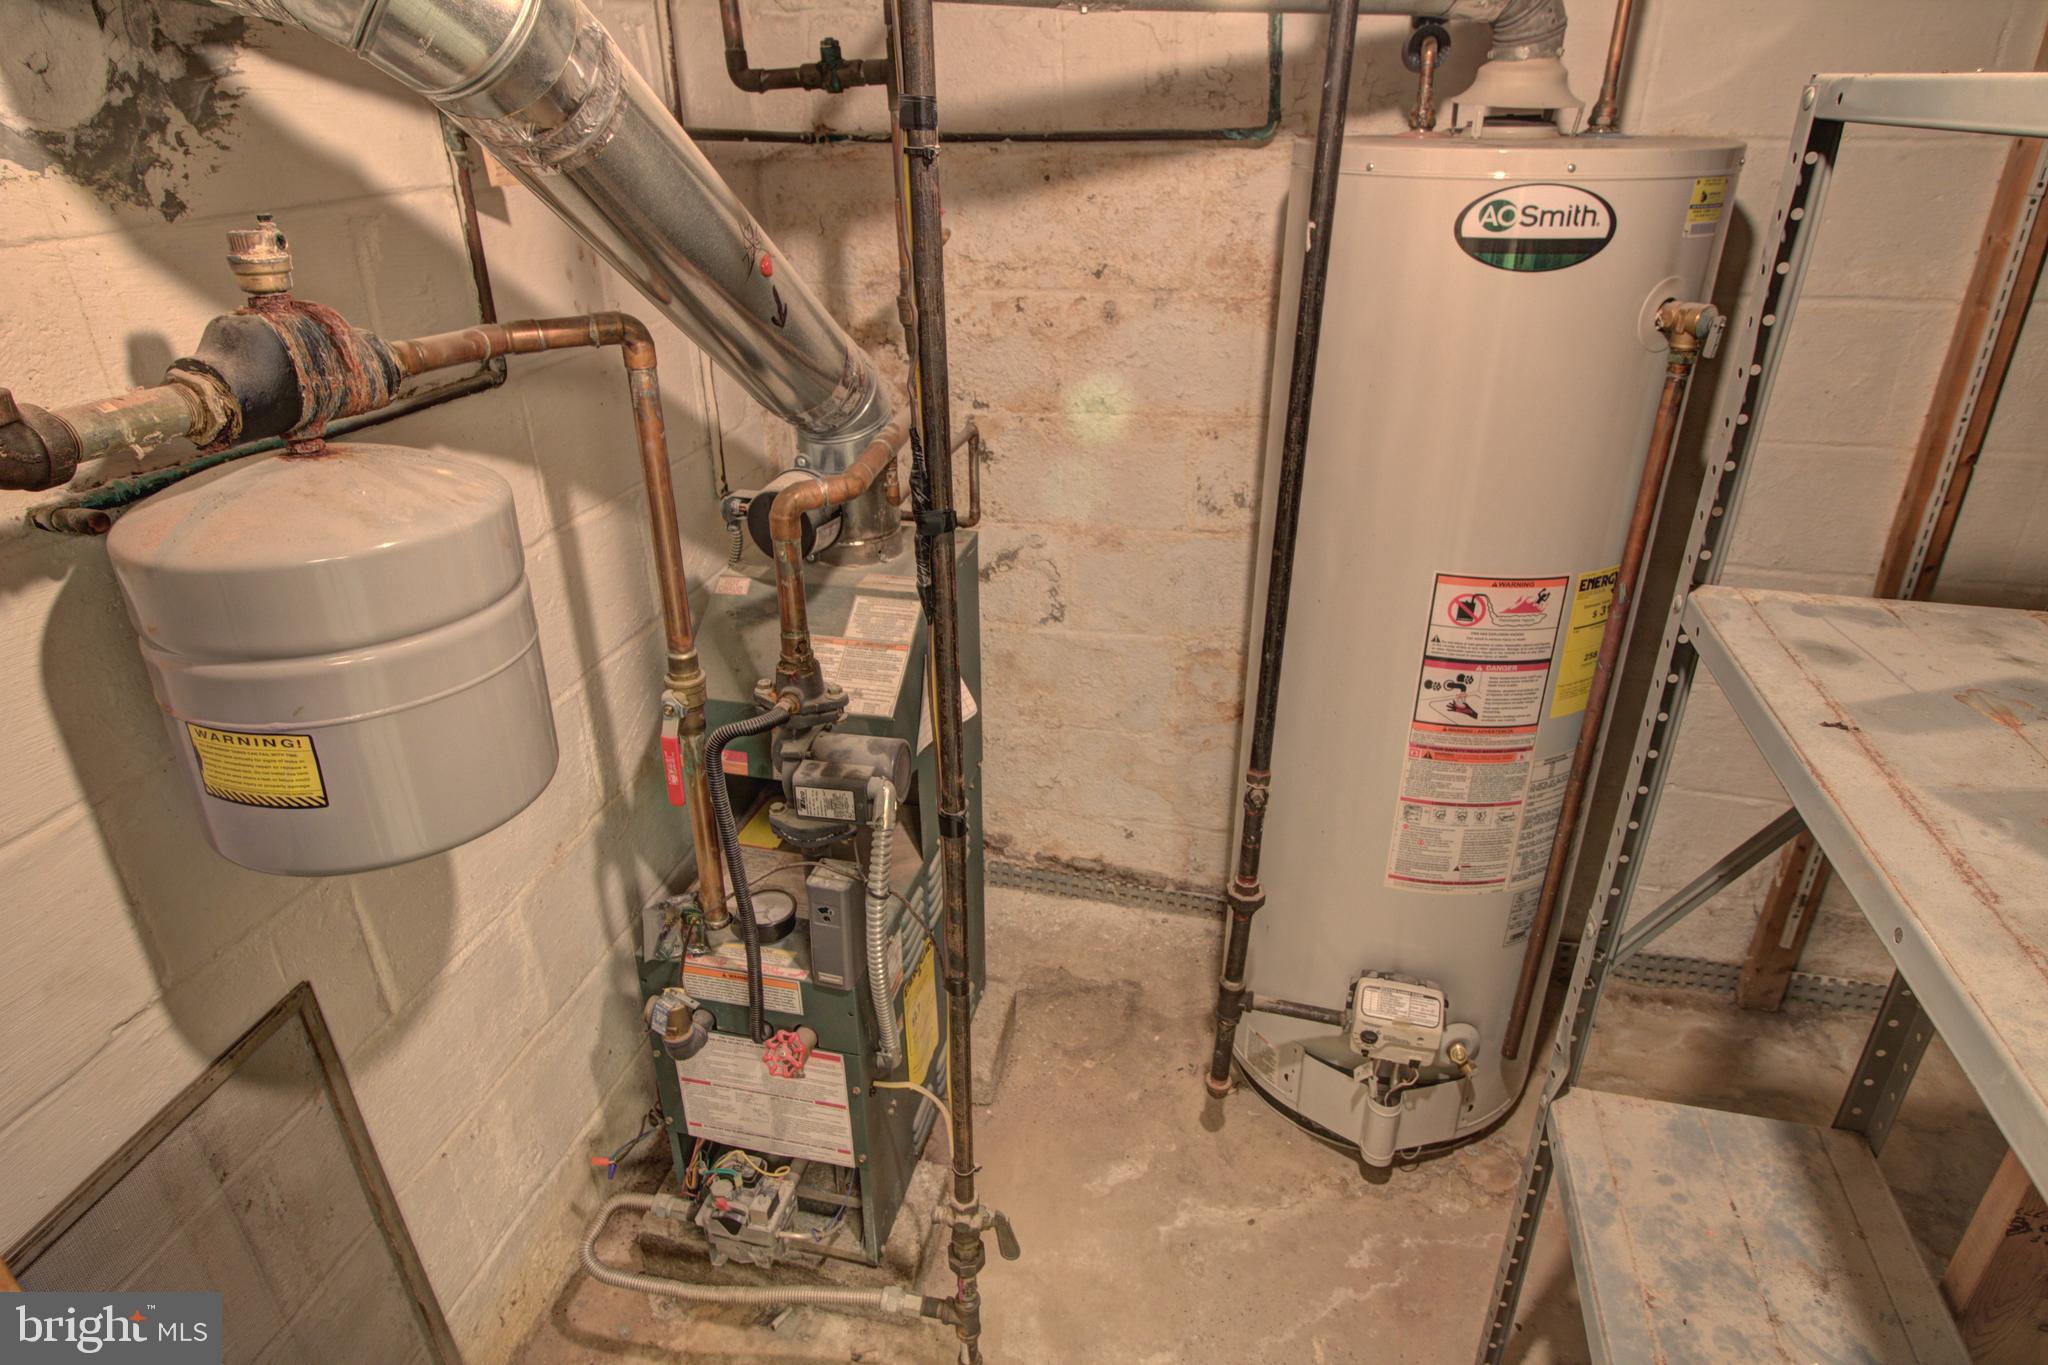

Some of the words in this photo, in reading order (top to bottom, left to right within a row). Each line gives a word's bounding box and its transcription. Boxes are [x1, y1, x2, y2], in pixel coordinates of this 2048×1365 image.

[1579, 571, 1618, 592] ENERG
[1486, 664, 1518, 672] DANGER
[194, 727, 303, 749] WARNING!
